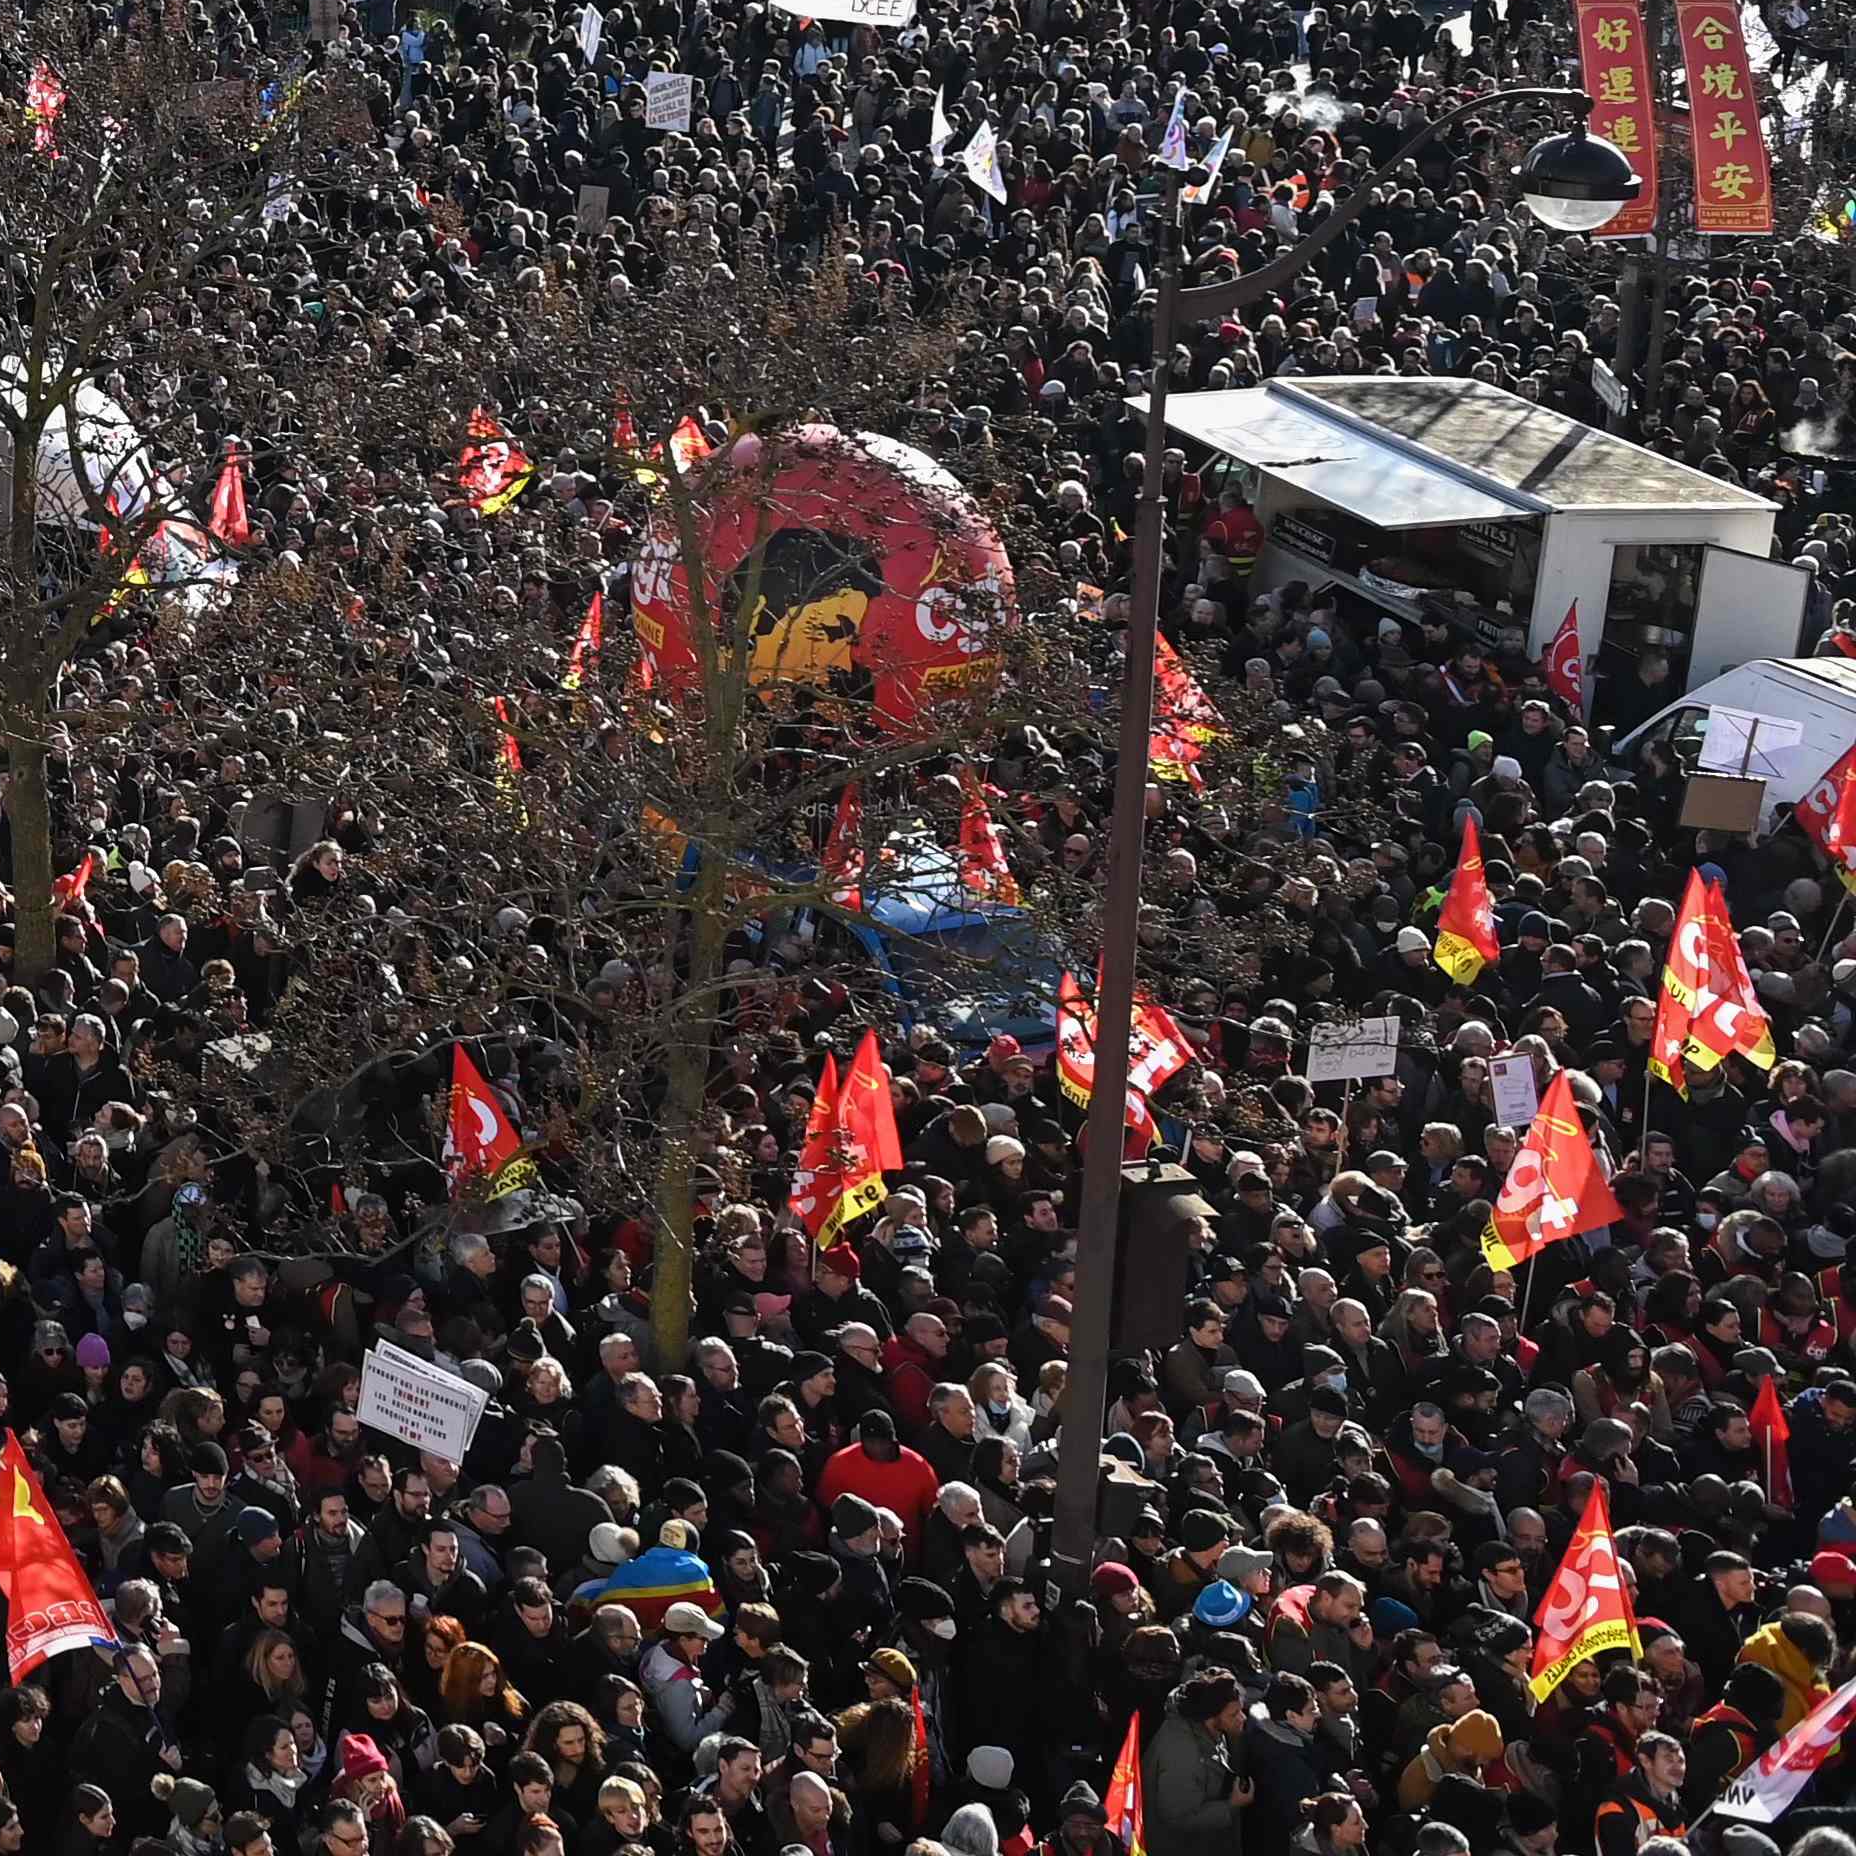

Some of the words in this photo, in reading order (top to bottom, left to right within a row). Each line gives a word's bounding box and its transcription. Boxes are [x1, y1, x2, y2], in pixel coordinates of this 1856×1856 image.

[1692, 15, 1754, 200] 合境平安
[400, 1379, 413, 1390] QUE
